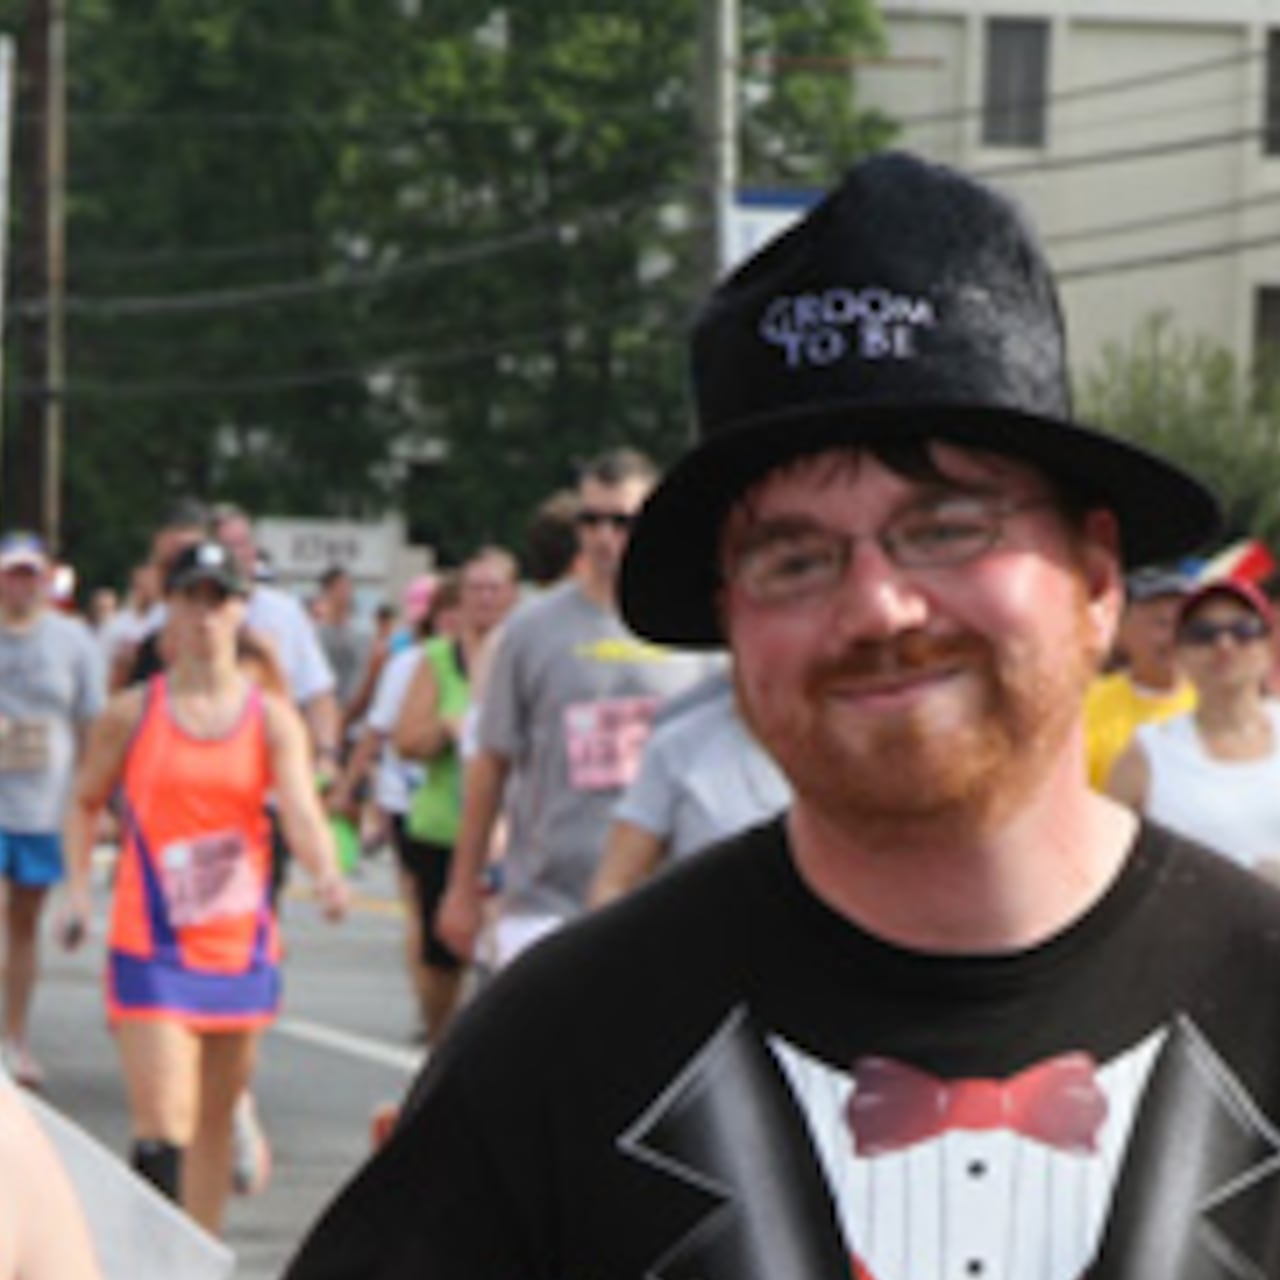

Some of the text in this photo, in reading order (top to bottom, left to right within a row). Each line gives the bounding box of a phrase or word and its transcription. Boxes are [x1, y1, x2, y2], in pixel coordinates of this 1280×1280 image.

[759, 286, 936, 343] GROOM
[783, 320, 917, 370] TO BE
